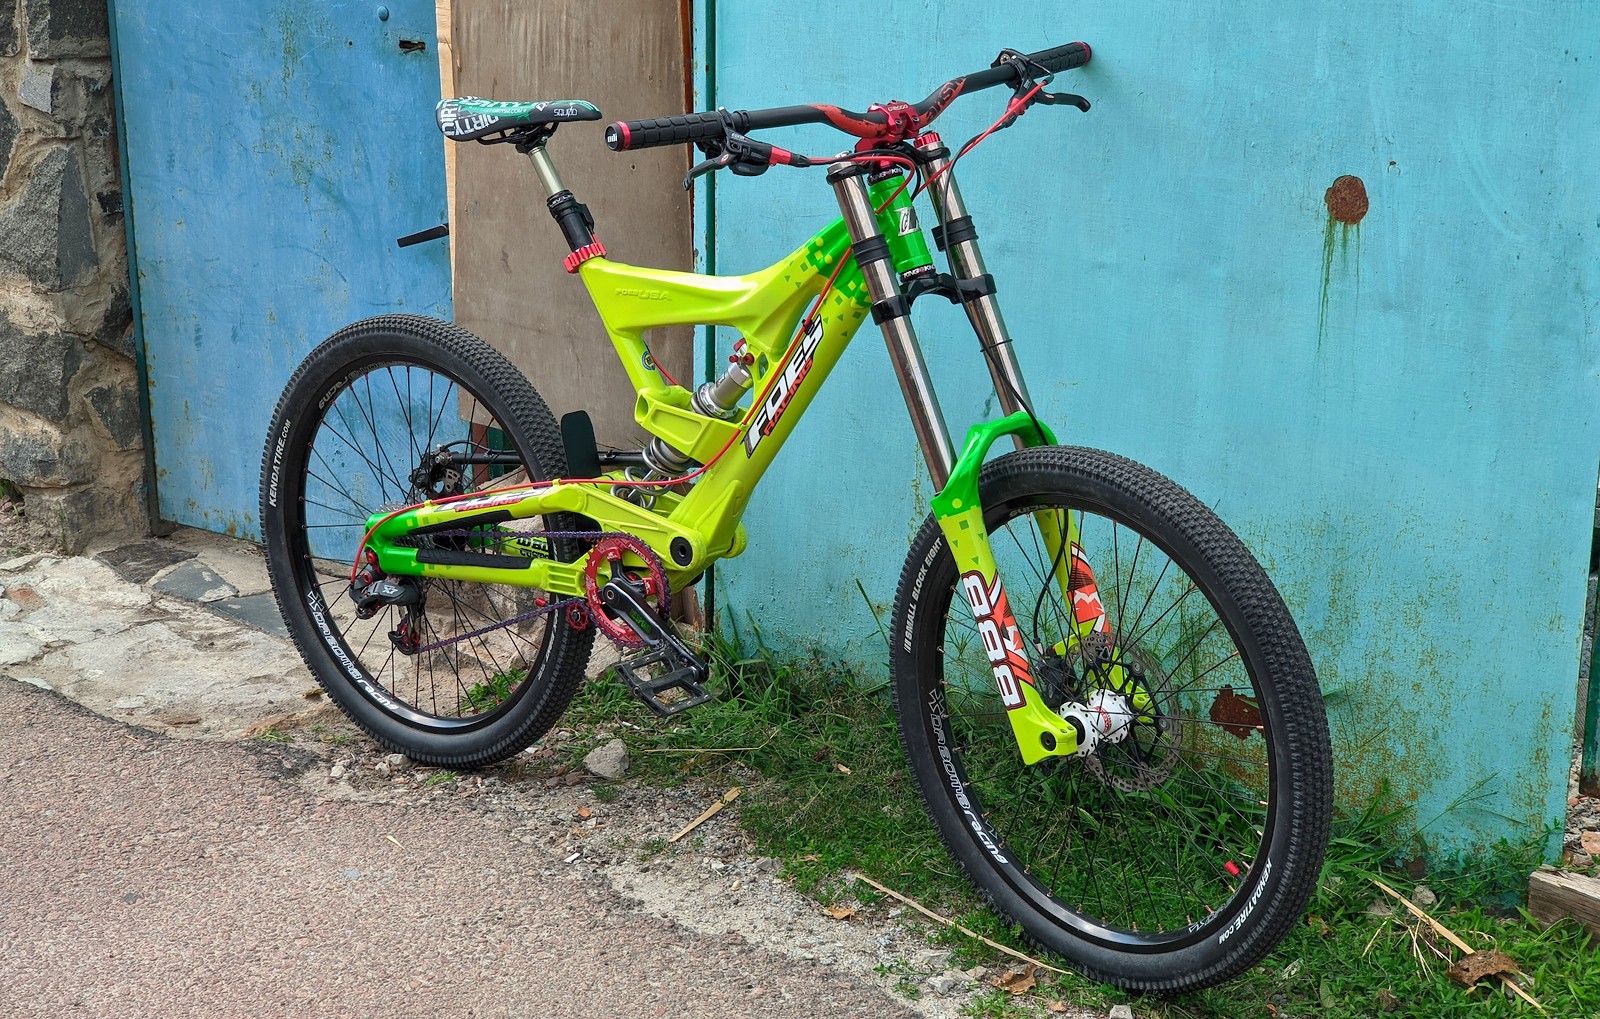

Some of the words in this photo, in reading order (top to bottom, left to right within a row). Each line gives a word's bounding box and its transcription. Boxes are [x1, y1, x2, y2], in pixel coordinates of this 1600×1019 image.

[638, 289, 672, 301] USA
[749, 316, 824, 456] FOES
[764, 358, 814, 437] RACING
[268, 419, 292, 508] KENDATIRE.COM
[905, 602, 917, 641] SMALL
[913, 566, 928, 602] BLOCK
[925, 537, 943, 567] EIGHT
[962, 574, 1021, 707] 888
[357, 679, 399, 711] racing
[963, 810, 1008, 865] racing
[1218, 857, 1272, 945] KENDATIRE.COM
